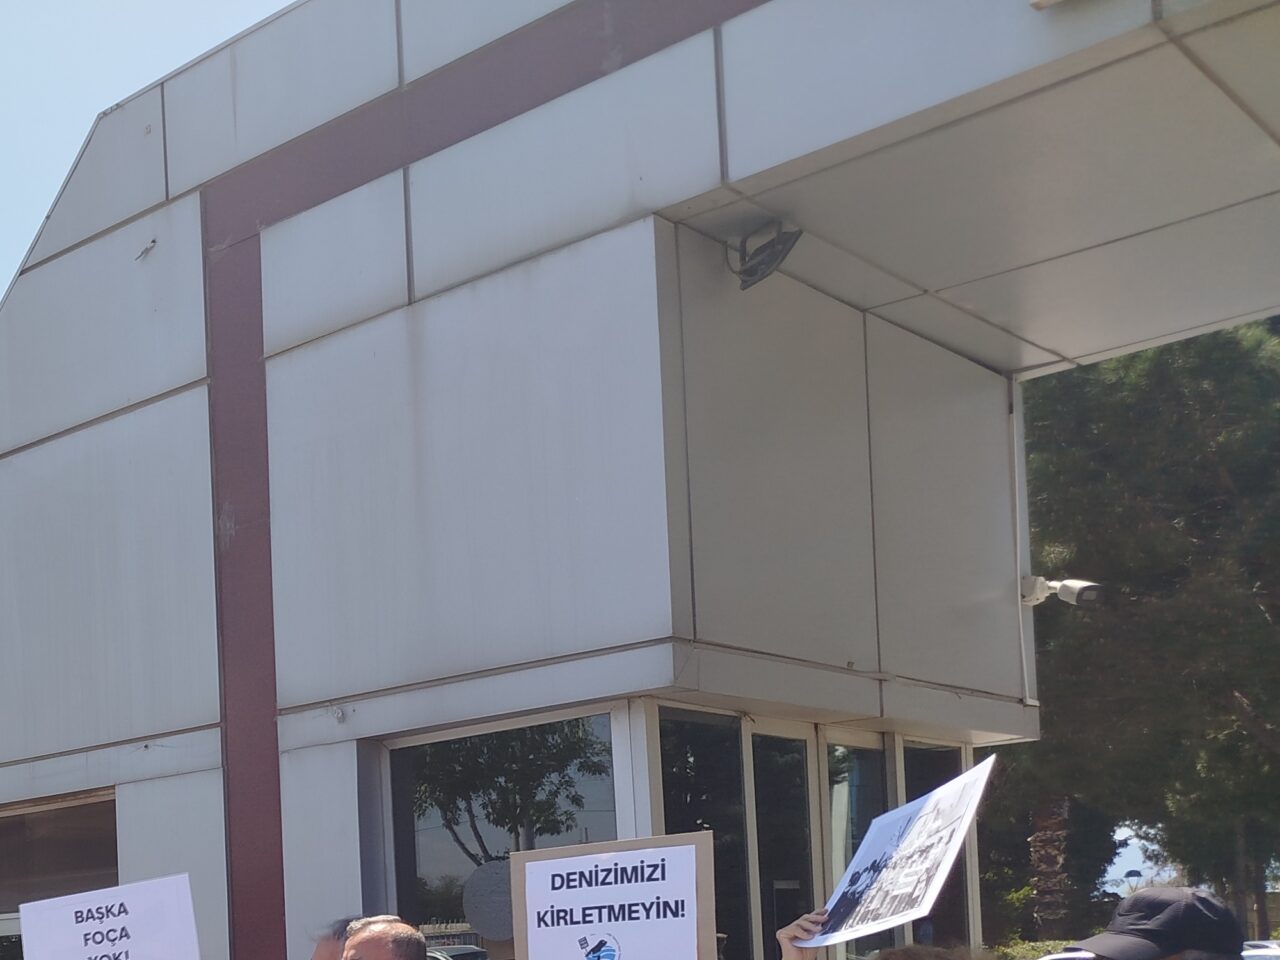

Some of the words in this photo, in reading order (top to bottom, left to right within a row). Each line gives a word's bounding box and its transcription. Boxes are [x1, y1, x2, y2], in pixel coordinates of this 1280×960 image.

[551, 857, 666, 891] DENİZİMİZİ
[74, 902, 129, 925] BAŞKA
[536, 895, 686, 929] KİRLETMEYİN!
[83, 925, 131, 947] FOÇA
